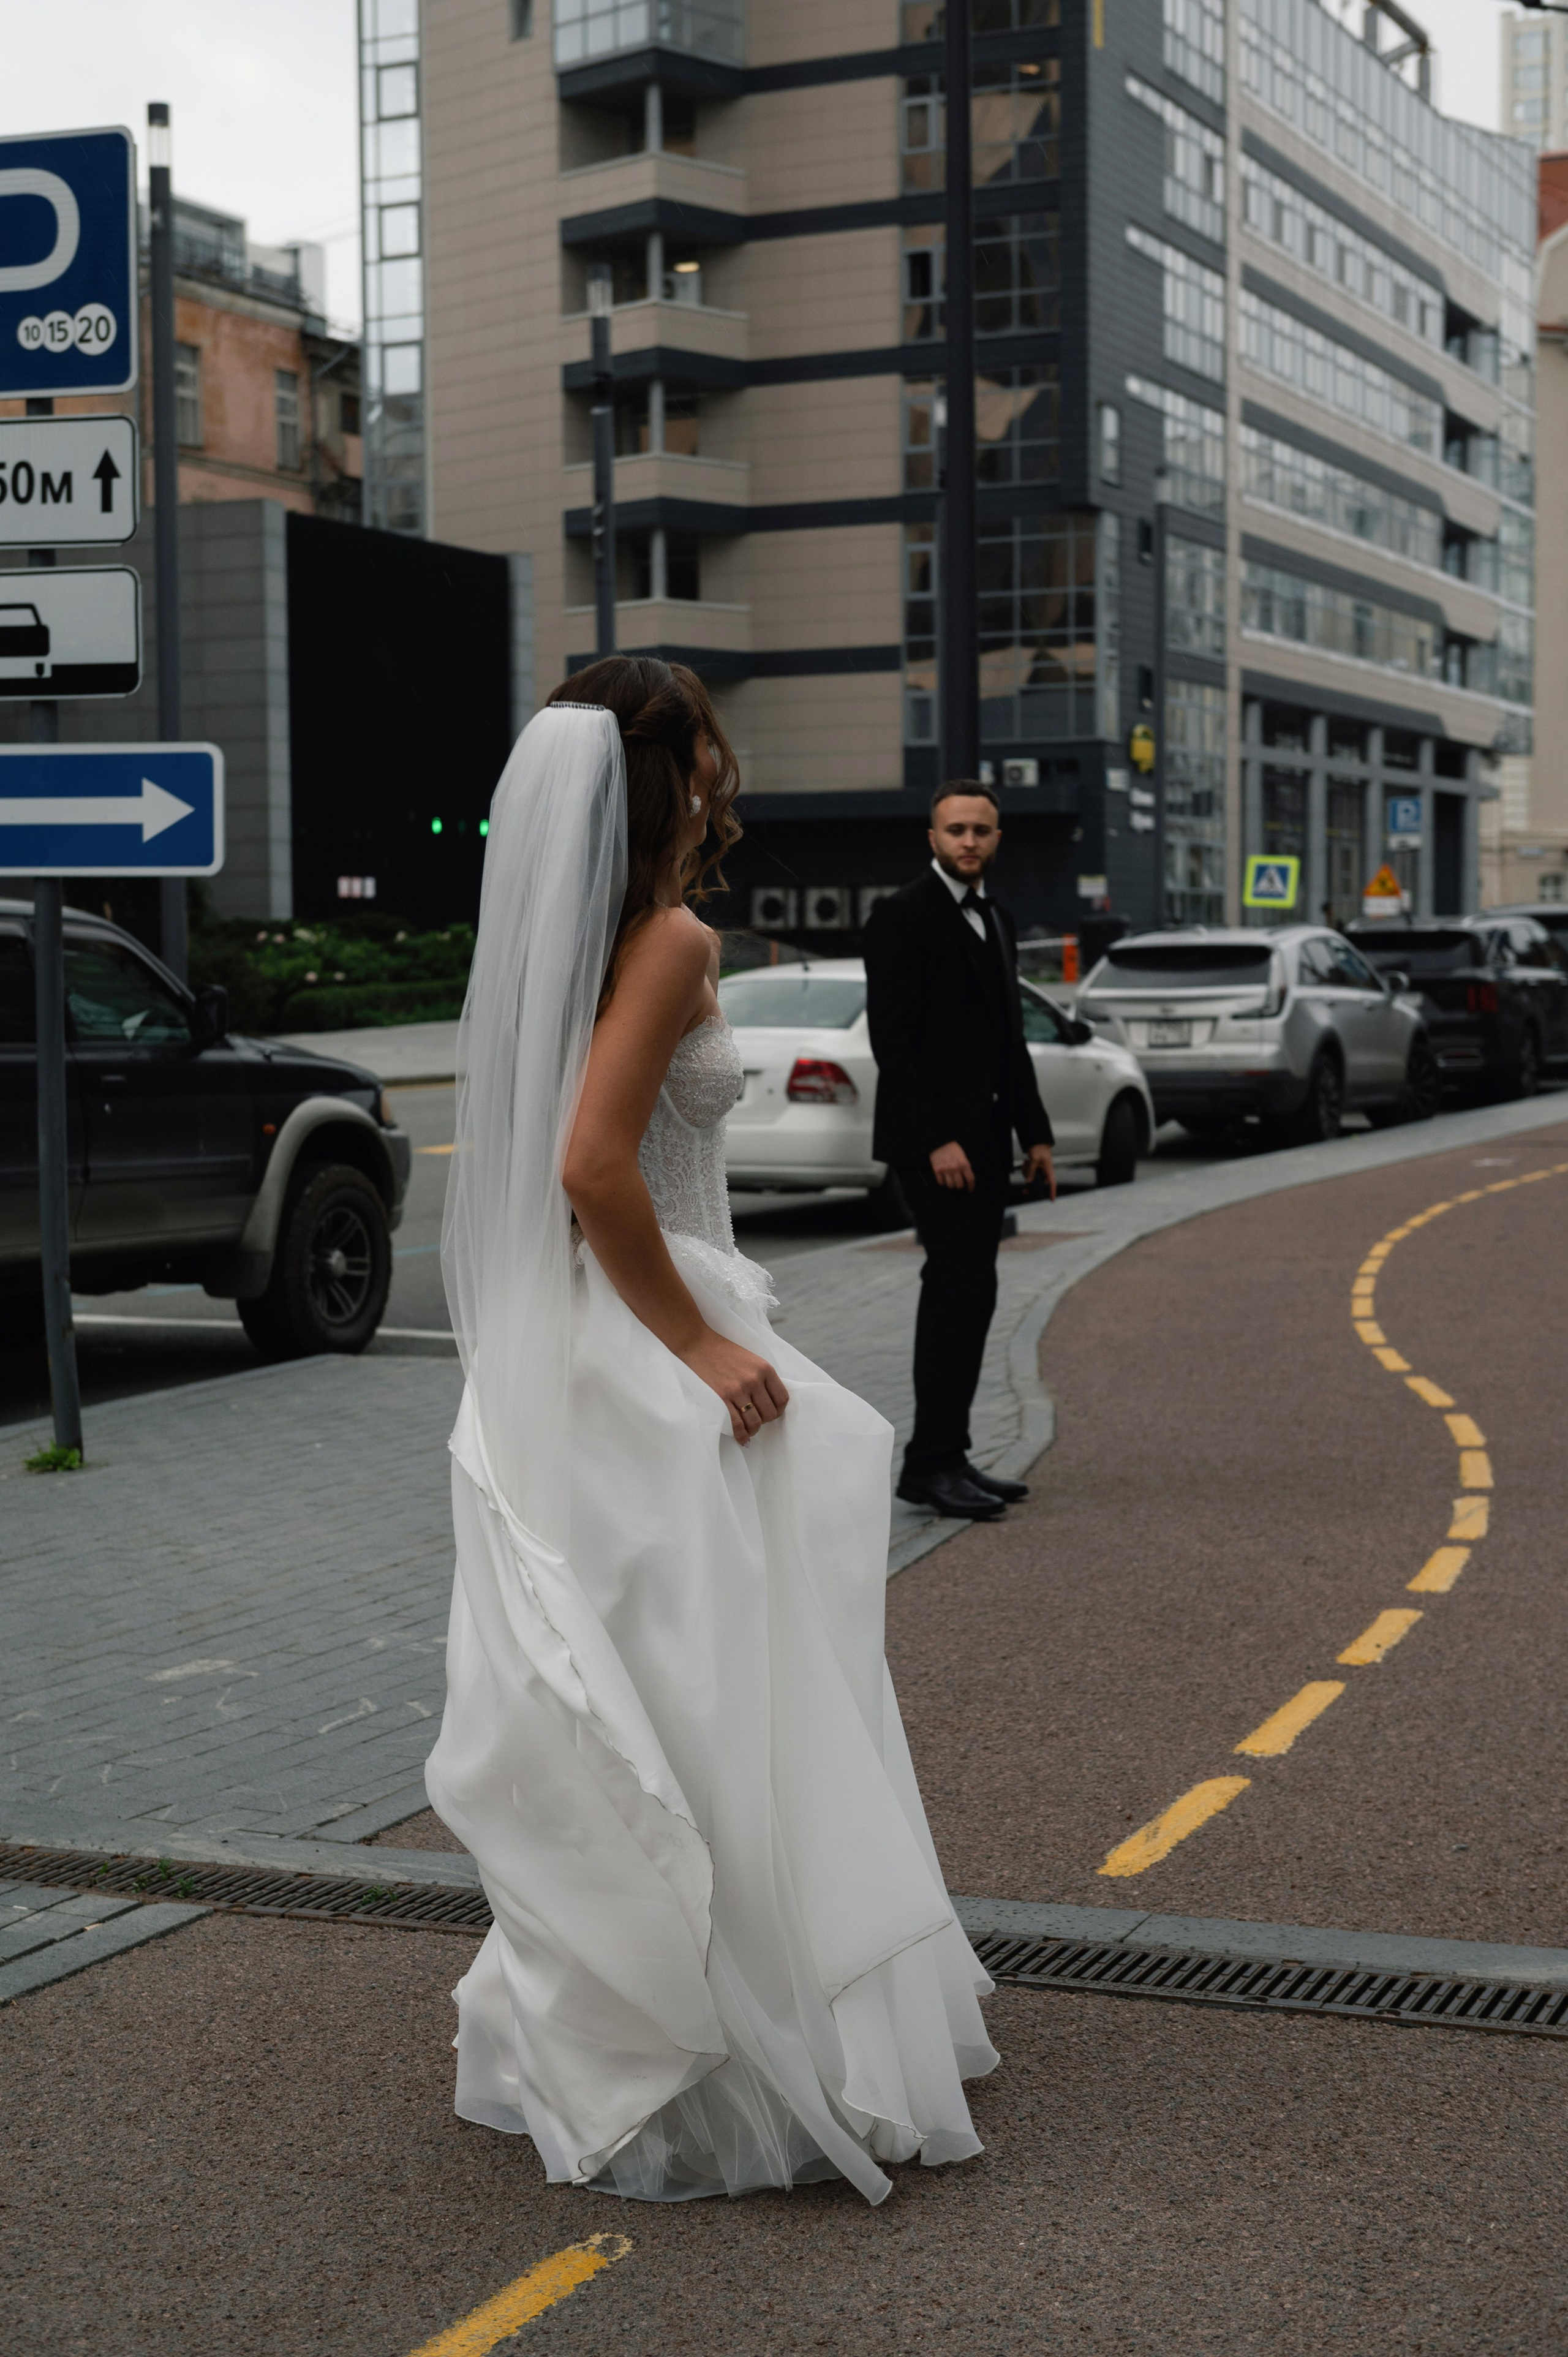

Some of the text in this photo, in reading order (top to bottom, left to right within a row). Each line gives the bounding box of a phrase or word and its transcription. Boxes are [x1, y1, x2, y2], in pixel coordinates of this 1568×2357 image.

[24, 315, 110, 343] 10 15 20
